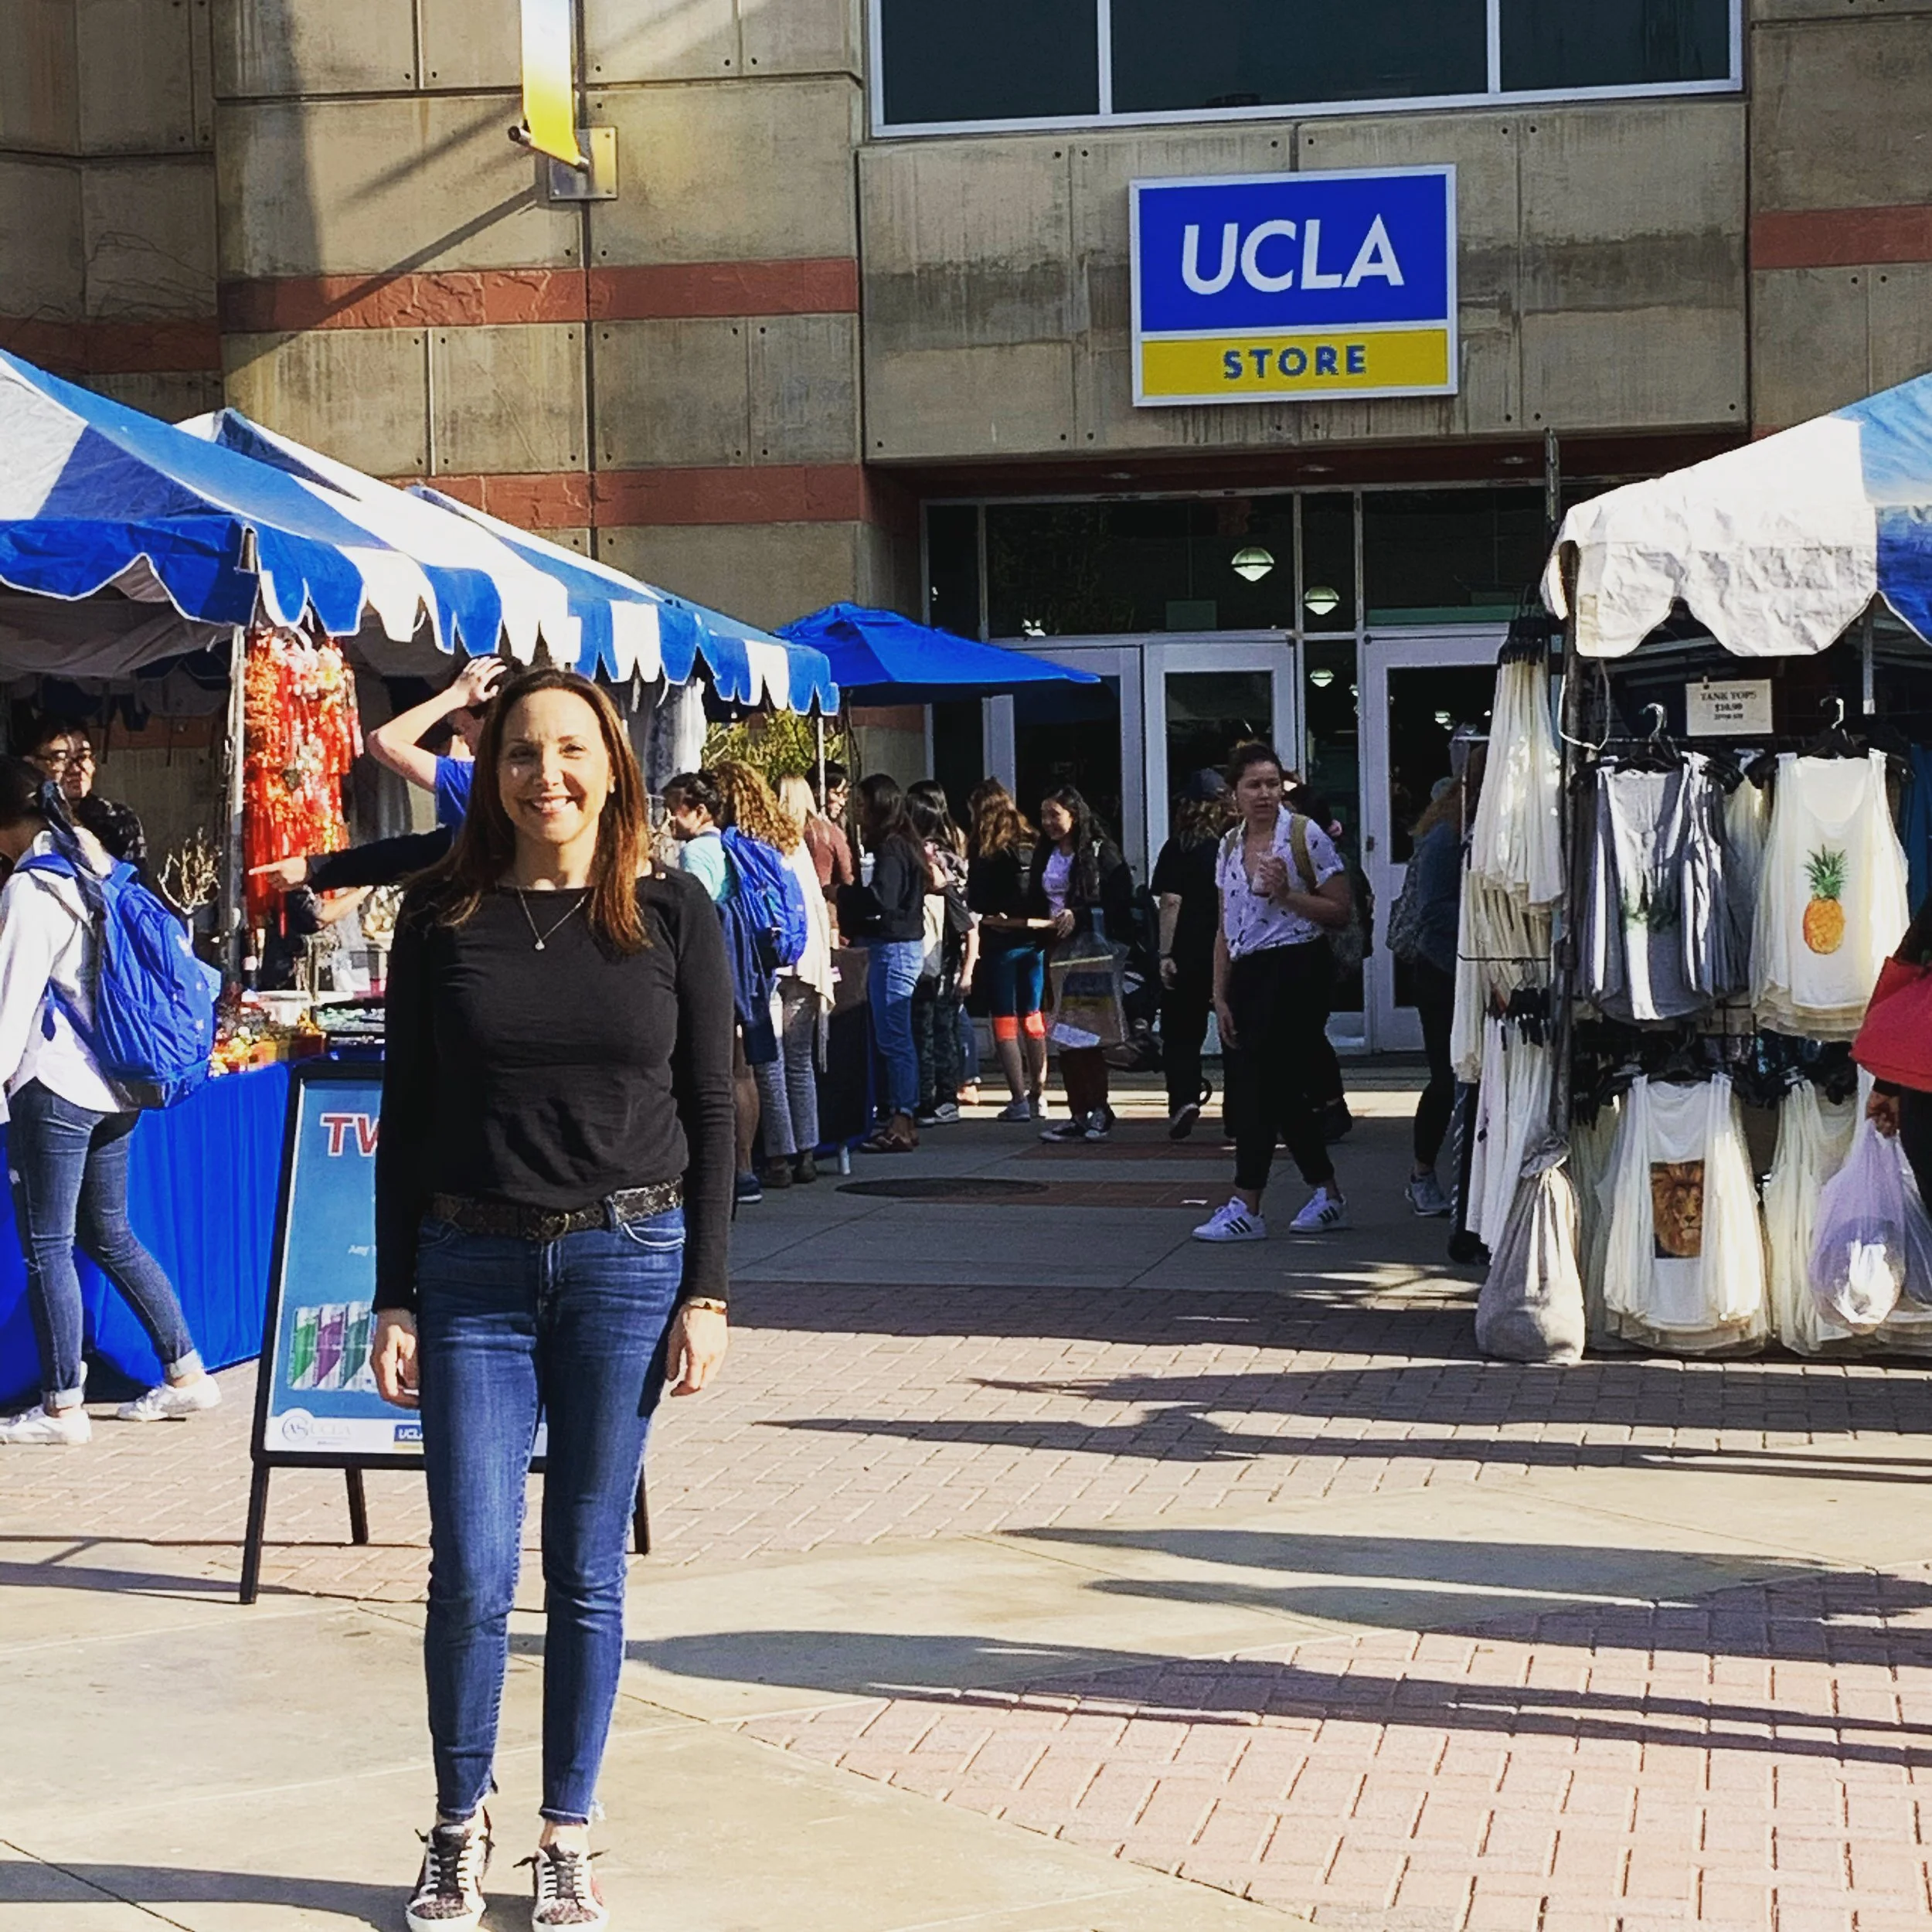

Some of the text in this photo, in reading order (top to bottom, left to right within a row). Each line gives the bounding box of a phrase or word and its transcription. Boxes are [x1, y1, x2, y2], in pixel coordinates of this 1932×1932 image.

[1182, 213, 1404, 295] UCLA
[1223, 345, 1366, 379] STORE
[1700, 691, 1757, 701] TANK TOPS
[398, 1428, 423, 1440] UCL
